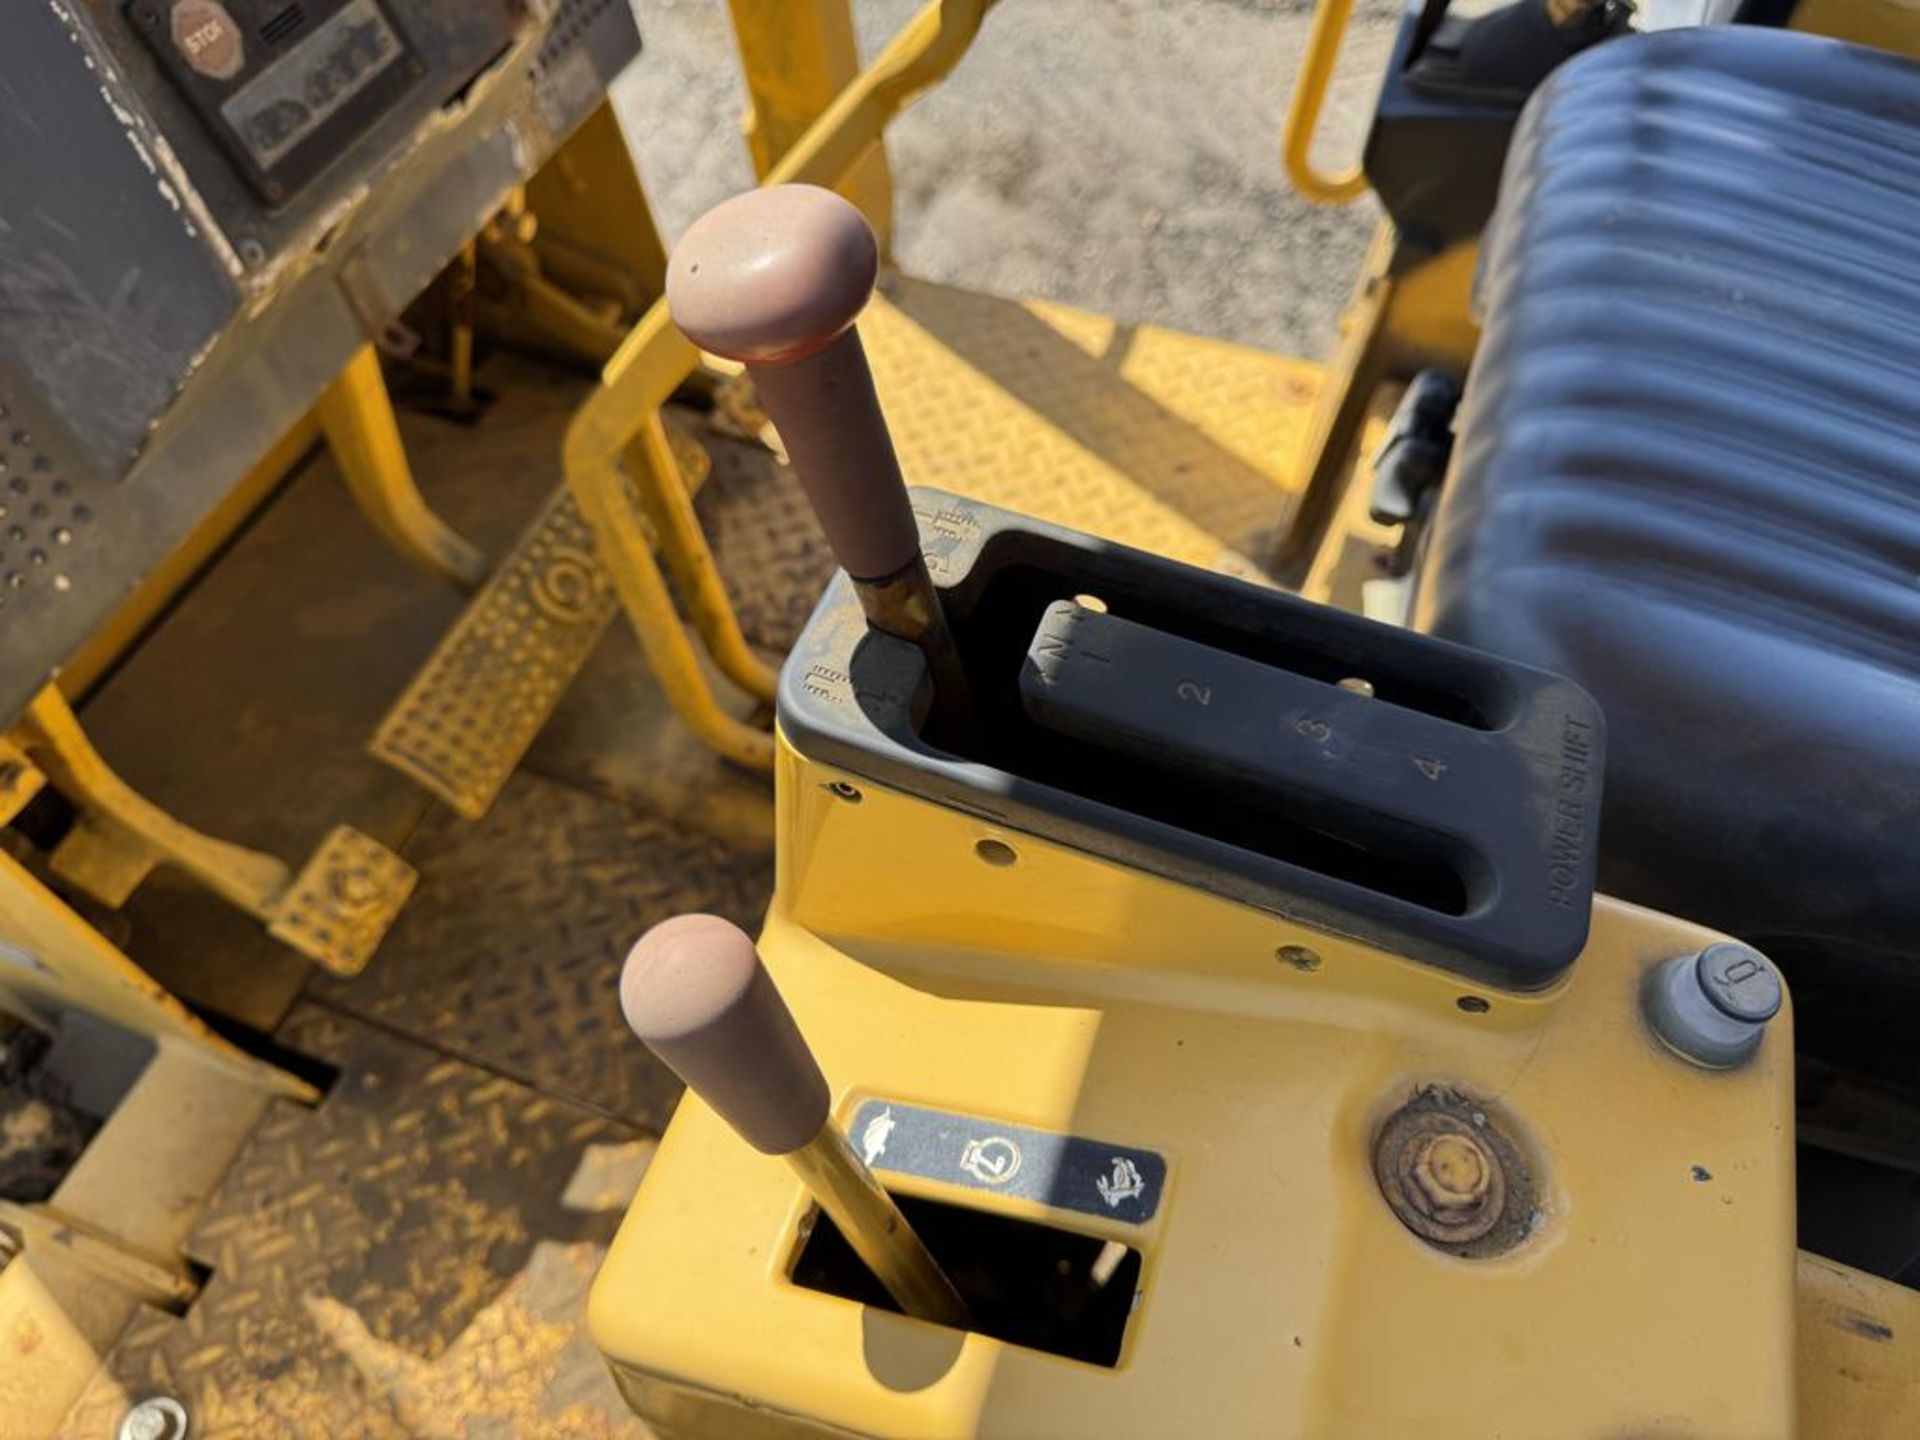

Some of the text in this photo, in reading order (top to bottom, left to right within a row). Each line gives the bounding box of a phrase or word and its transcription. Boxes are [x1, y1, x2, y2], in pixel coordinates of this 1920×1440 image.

[1037, 632, 1074, 660] N
[1177, 681, 1212, 706] 2
[1298, 718, 1332, 743] 3
[1413, 756, 1447, 781] 4
[1547, 714, 1592, 908] POWER SHIFT
